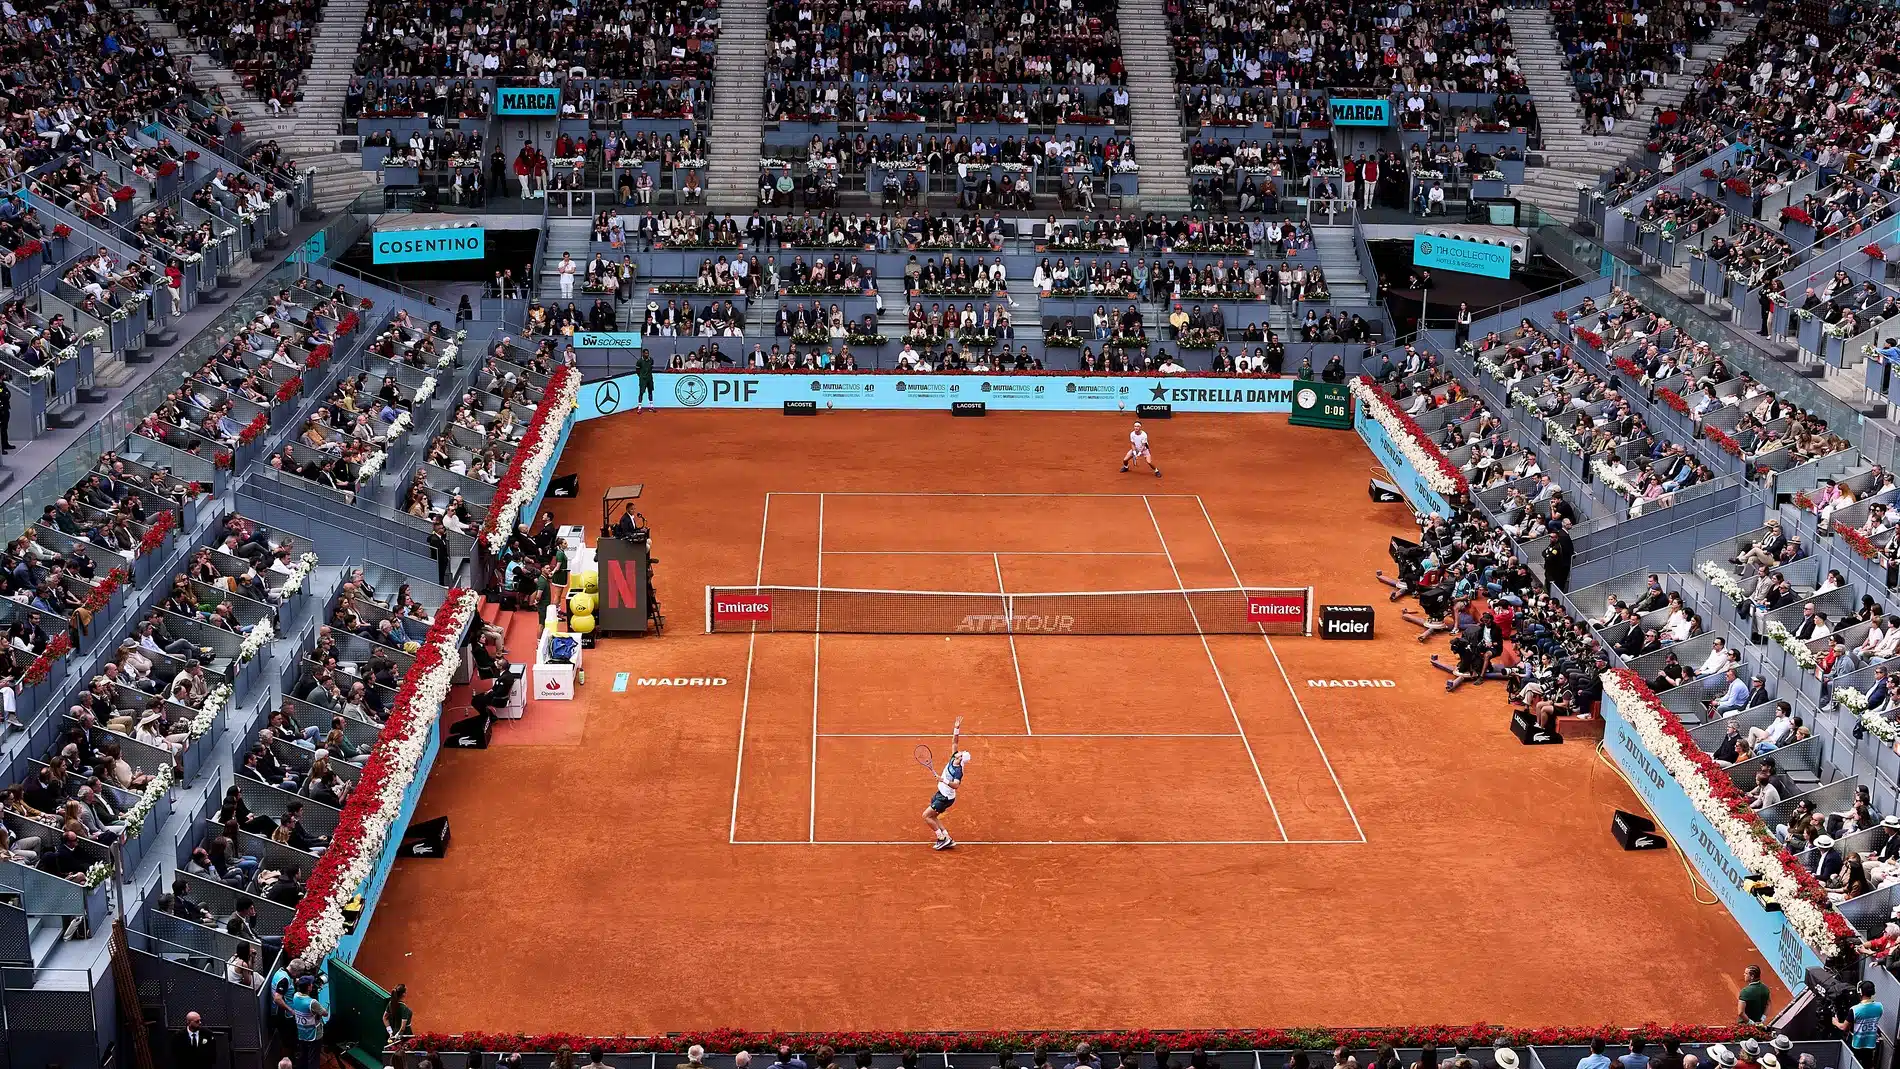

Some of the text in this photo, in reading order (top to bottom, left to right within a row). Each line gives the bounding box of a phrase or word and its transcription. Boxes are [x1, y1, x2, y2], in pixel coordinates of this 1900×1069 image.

[503, 94, 556, 109] MARCA
[1332, 105, 1383, 120] MARCA
[379, 237, 479, 254] COSENTINO
[1450, 247, 1505, 264] COLLECTION
[1436, 258, 1456, 266] HOTELS
[1461, 262, 1485, 270] RESORTS
[597, 338, 632, 347] SCORES
[713, 380, 759, 402] PIF
[864, 384, 875, 392] 40
[949, 384, 960, 393] 40
[1034, 385, 1045, 394] 40
[1119, 386, 1129, 394] 40
[1172, 389, 1293, 403] ESTRELLA DAMM
[1324, 405, 1345, 416] 0:06
[1418, 483, 1441, 512] DUNLOP
[608, 560, 637, 609] N
[717, 602, 769, 613] Emirates
[1250, 603, 1301, 615] Emirates
[956, 614, 1075, 632] ATP TOUR
[1328, 619, 1370, 633] Haier
[637, 678, 728, 686] MADRID
[1307, 679, 1396, 688] MADRID
[1625, 736, 1666, 790] DUNLOP
[1698, 829, 1745, 892] DUNLOP
[1694, 852, 1736, 909] OFFICIAL BALL
[1780, 923, 1803, 965] MUTUA
[1778, 940, 1803, 980] MADRID
